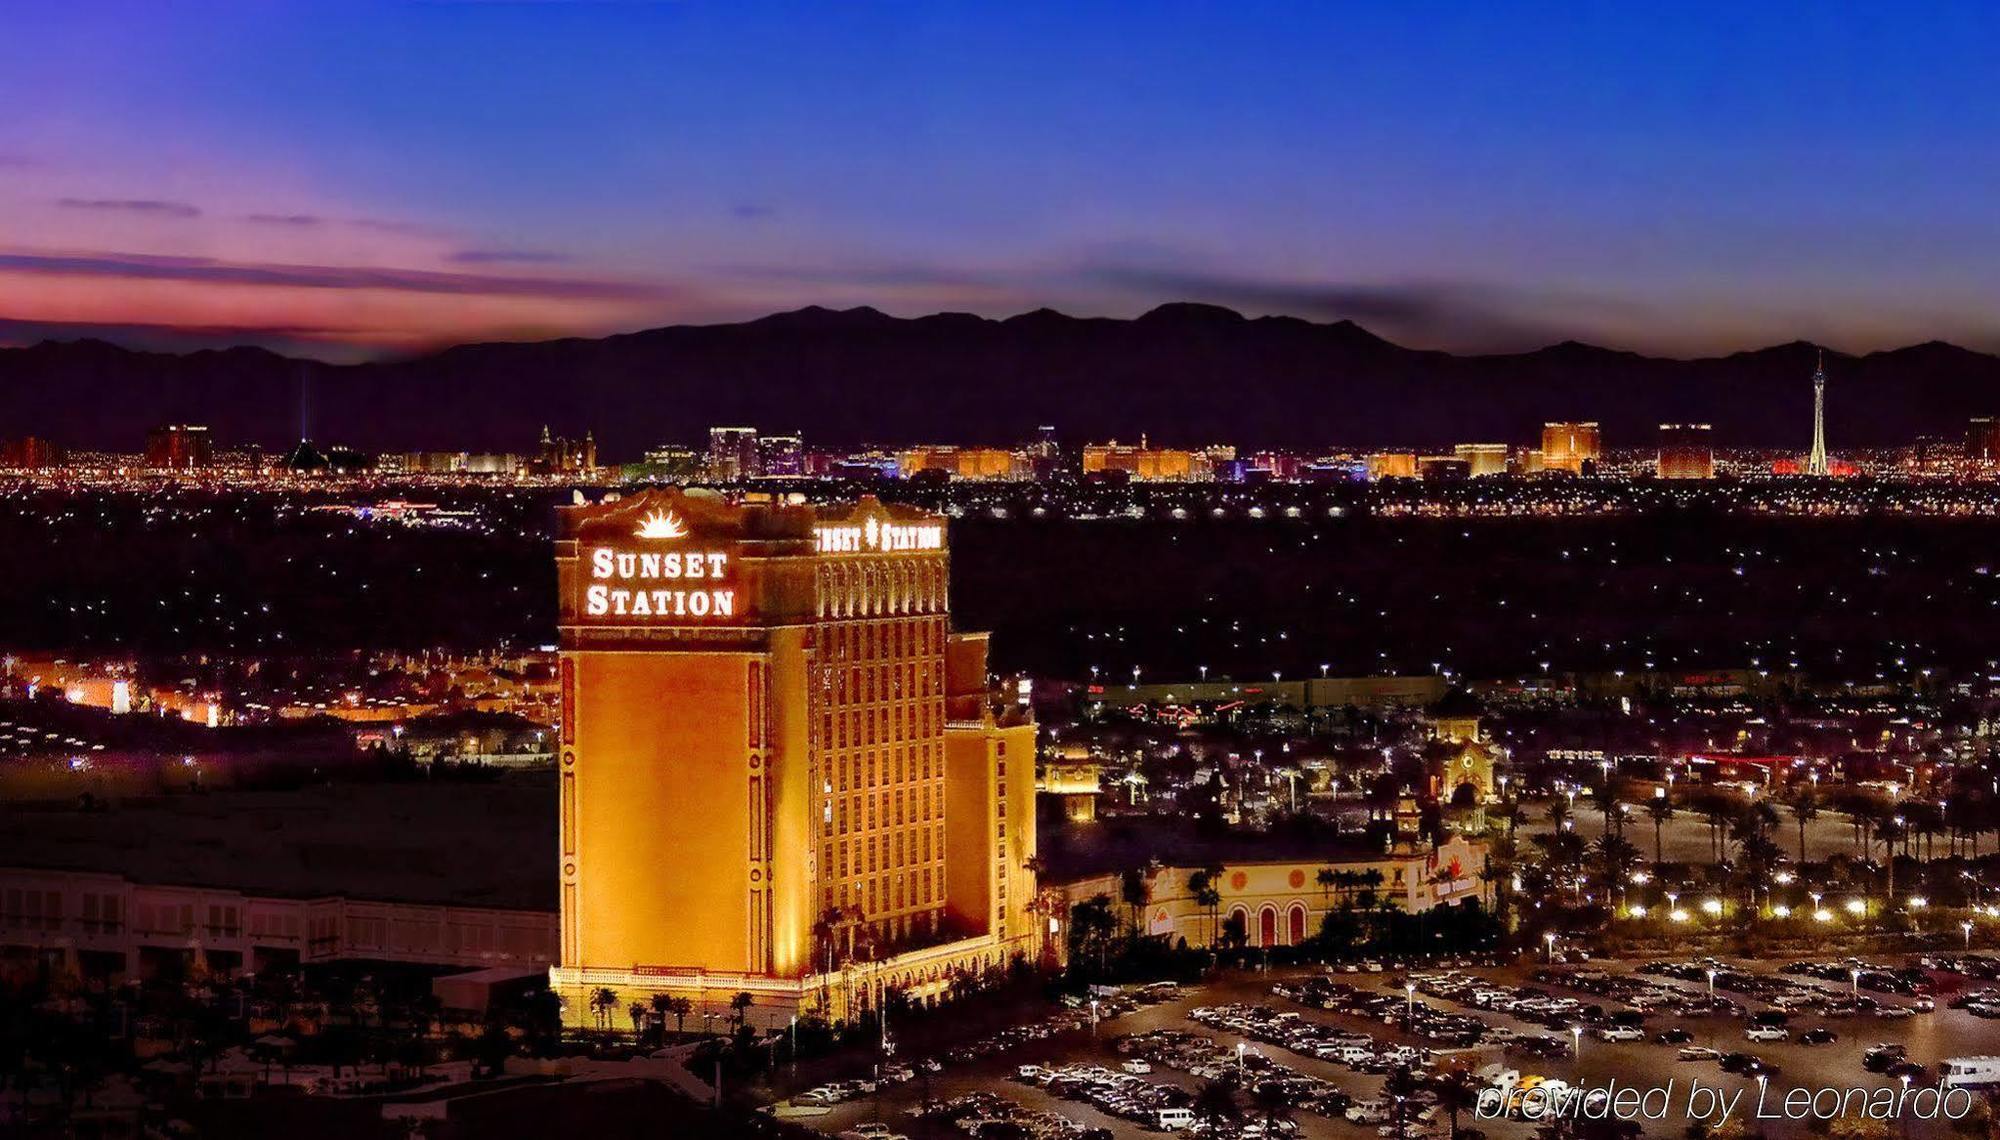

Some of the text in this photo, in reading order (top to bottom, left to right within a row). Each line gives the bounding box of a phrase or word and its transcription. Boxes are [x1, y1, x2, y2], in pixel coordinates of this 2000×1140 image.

[881, 523, 941, 552] STATION
[592, 548, 728, 579] SUNSET
[587, 585, 735, 616] STATION
